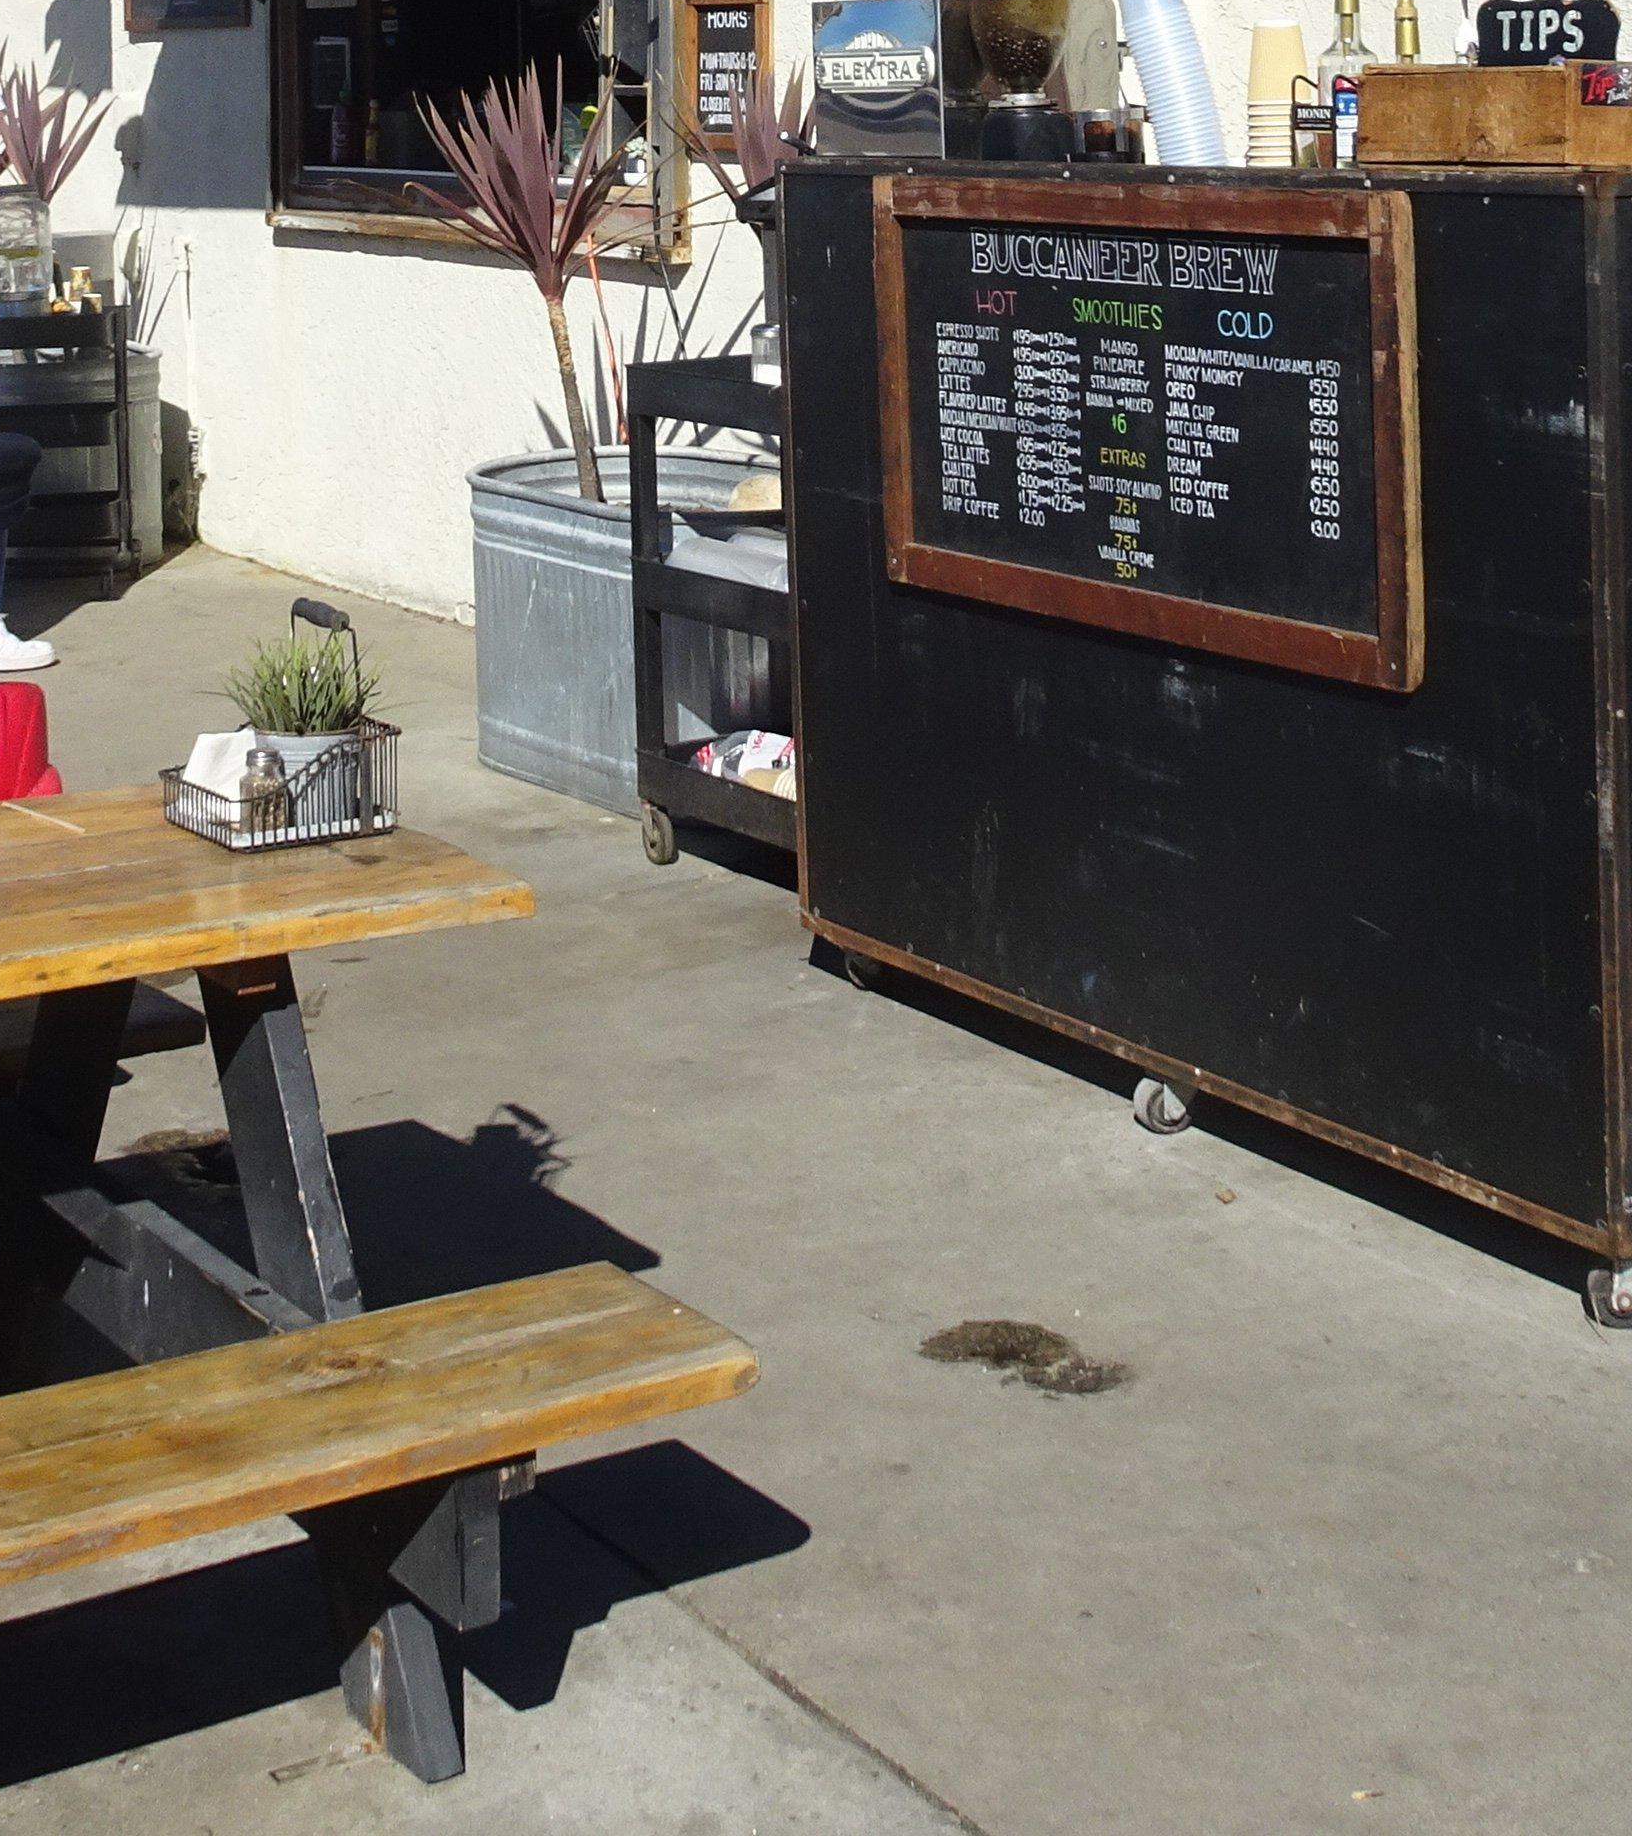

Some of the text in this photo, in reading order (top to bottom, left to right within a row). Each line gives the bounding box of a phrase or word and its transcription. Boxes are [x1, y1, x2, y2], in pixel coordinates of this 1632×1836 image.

[1496, 9, 1584, 53] TIPS
[831, 61, 914, 81] ELEKTRA
[1297, 108, 1331, 119] MONIN
[970, 228, 1279, 295] BUCCANEER BREW
[975, 290, 1018, 315] HOT
[1072, 297, 1163, 331] SMOOTHIES
[1217, 310, 1273, 339] COLD
[936, 322, 973, 339] ESPRESSO
[975, 325, 1000, 341] SHOTS
[937, 339, 979, 357] AMERICANO
[1100, 338, 1139, 356] MANGO
[938, 356, 986, 376] CAPPUCCINO
[1093, 356, 1145, 375] PINEAPPLE
[1165, 363, 1200, 383] FUNKY
[1201, 367, 1244, 387] MONKEY
[938, 374, 971, 391] LATTES
[1090, 374, 1150, 394] STRAWBERRY
[1166, 382, 1196, 400] OREO
[938, 390, 976, 410] FLAVORED
[977, 395, 1007, 413] LATTES
[1124, 396, 1154, 414] MIXED
[1166, 400, 1190, 418] JAVA
[1192, 404, 1216, 422] CHIP
[1111, 413, 1127, 434] $6
[1165, 419, 1203, 438] MATCHA
[1205, 424, 1239, 443] GREEN
[940, 426, 956, 442] HOT
[958, 428, 984, 446] COCOA
[941, 442, 959, 460] TEA
[960, 445, 990, 465] LATTES
[1100, 447, 1147, 469] EXTRAS
[1166, 437, 1190, 454] CHAI
[1193, 440, 1214, 458] TEA
[942, 460, 960, 476] CHAI
[961, 462, 976, 479] TEA
[1167, 455, 1202, 477] DREAM
[942, 477, 959, 494] HOT
[960, 479, 977, 497] TEA
[1169, 476, 1192, 495] ICED
[1194, 480, 1229, 500] COFFEE
[943, 495, 962, 512] DRIP
[965, 499, 1000, 519] COFFEE
[1170, 496, 1193, 514] ICED
[1195, 499, 1215, 519] TEA
[1098, 545, 1155, 569] VANILLA CREME
